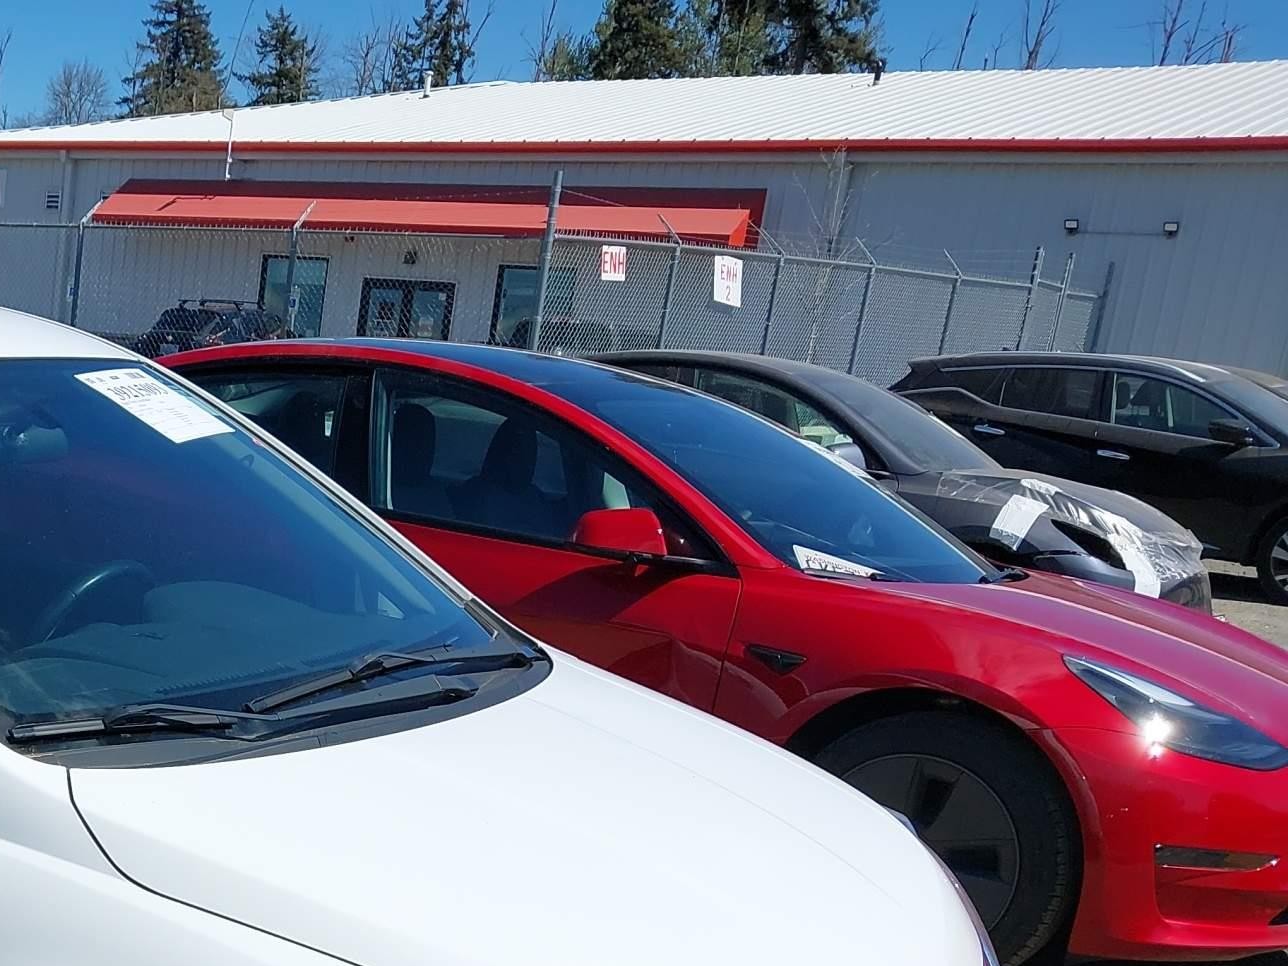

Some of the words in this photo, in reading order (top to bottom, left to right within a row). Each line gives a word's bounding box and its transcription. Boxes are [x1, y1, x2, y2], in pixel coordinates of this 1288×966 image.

[602, 251, 625, 275] ENH
[720, 264, 738, 281] ENH
[725, 285, 731, 301] 2
